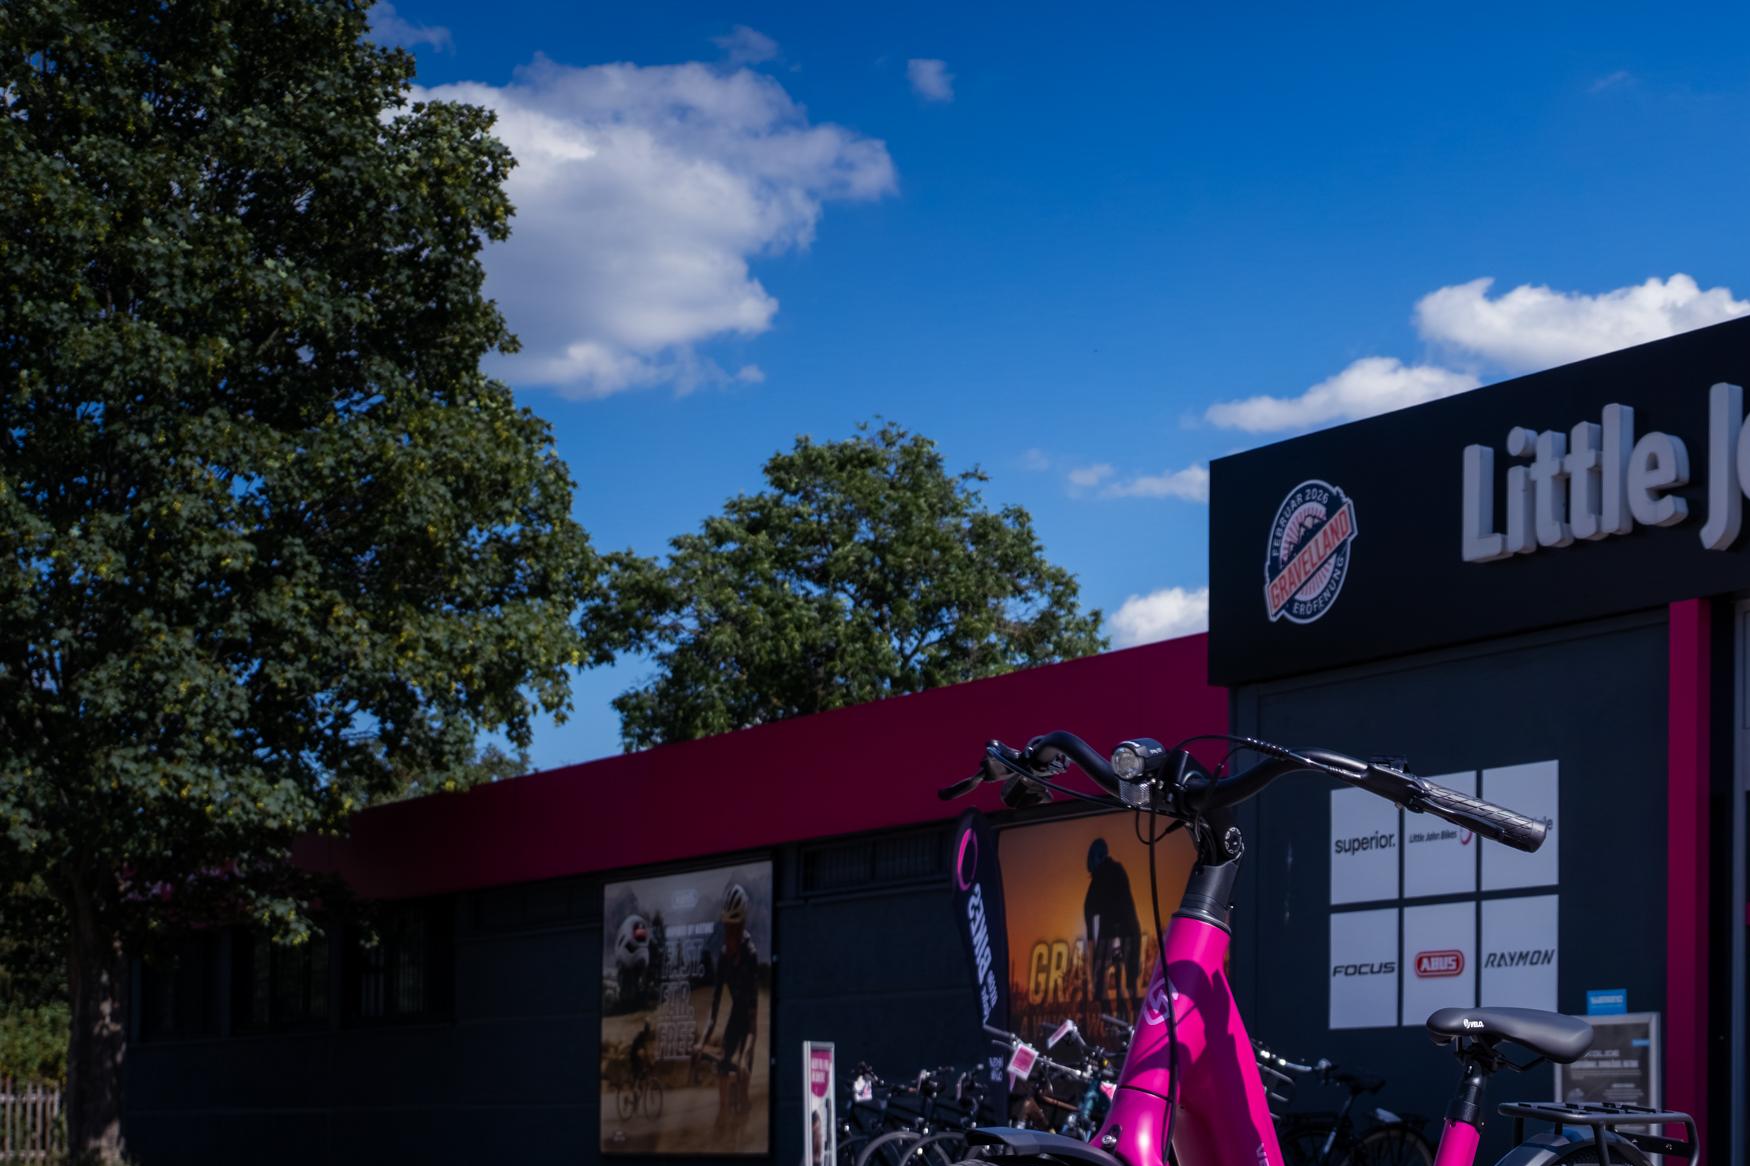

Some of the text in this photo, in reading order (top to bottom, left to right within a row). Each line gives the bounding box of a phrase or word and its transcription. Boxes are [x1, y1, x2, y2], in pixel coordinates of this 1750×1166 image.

[1462, 403, 1690, 563] Little
[1272, 492, 1303, 557] FEBRUAR
[1270, 509, 1351, 609] GRAVELLAND
[1334, 831, 1396, 856] superior.
[1332, 961, 1396, 977] FOCUS
[1419, 954, 1458, 973] ABUS
[1484, 949, 1556, 969] RAYMON
